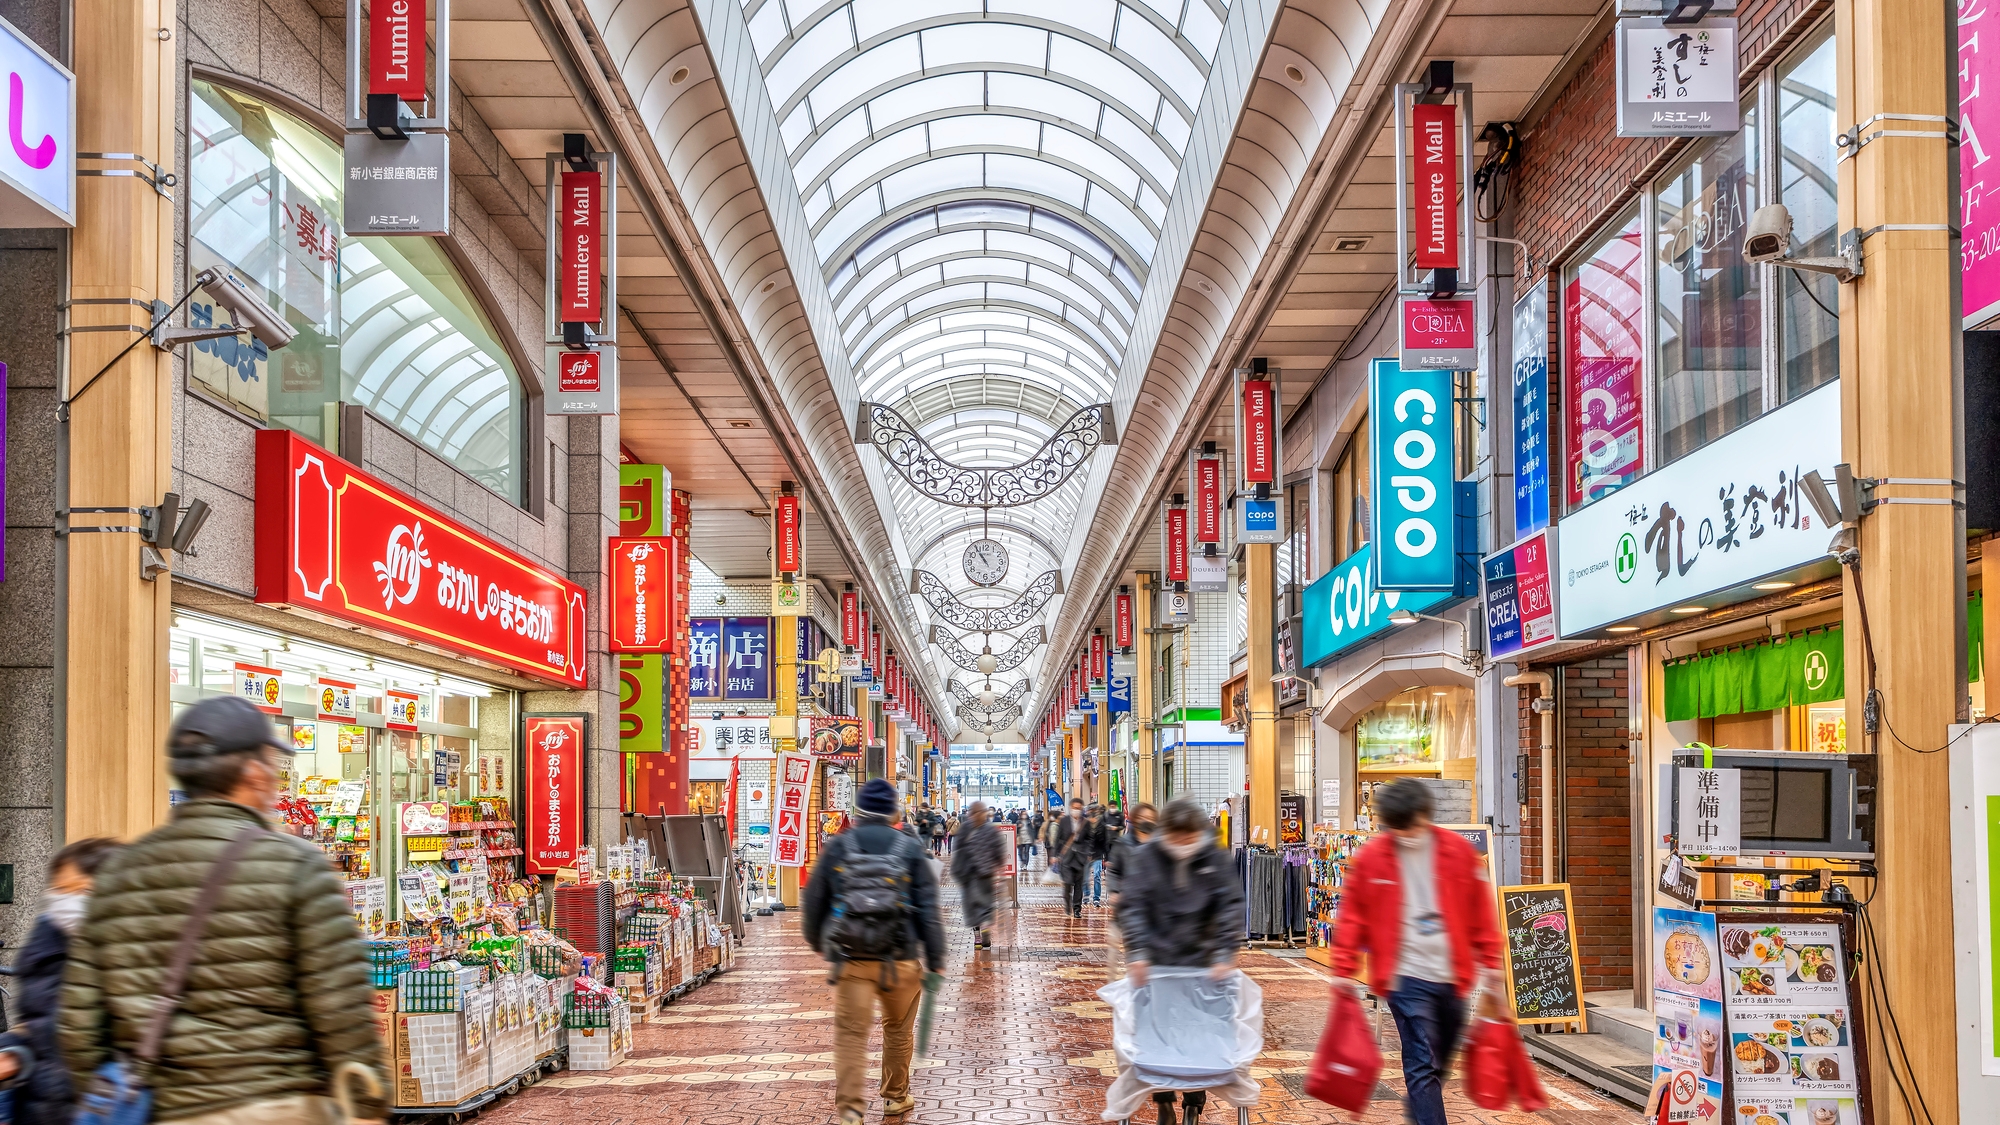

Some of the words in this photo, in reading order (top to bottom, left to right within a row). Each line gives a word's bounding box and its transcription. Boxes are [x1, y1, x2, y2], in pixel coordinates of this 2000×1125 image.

[1652, 111, 1711, 122] ルミエール
[1426, 120, 1443, 164] Mall
[350, 166, 438, 180] 新小岩銀座商店街
[368, 215, 419, 224] ルミエール
[573, 186, 590, 227] Mall
[1428, 172, 1445, 255] Lumiere
[1960, 180, 1984, 229] F
[573, 234, 590, 310] Lumiere
[1412, 314, 1466, 334] CREA
[1522, 298, 1537, 330] 3F
[1420, 356, 1460, 364] ルミエール
[1515, 347, 1544, 388] CREA
[1253, 390, 1264, 417] Mall
[1254, 421, 1265, 473] Lumiere
[1204, 467, 1213, 489] Mall
[1391, 388, 1437, 558] copo
[785, 503, 793, 525] Mall
[1174, 516, 1182, 535] Mall
[1204, 493, 1214, 535] Lumiere
[1248, 512, 1274, 520] copo
[785, 528, 793, 564] Lumiere
[1174, 538, 1182, 574] Lumiere
[1527, 545, 1537, 563] 2F
[1494, 562, 1504, 579] 3F
[1576, 569, 1589, 580] TOKYO
[1589, 560, 1609, 576] SETAGAYA
[437, 560, 553, 645] おかしのまちおか
[634, 564, 647, 645] おかしのまちおか
[1330, 555, 1402, 637] cop
[1520, 581, 1552, 615] CREA
[1489, 599, 1519, 628] CREA
[547, 650, 565, 667] 新小岩店
[548, 754, 560, 847] おかしのまちおか
[778, 760, 808, 861] 新台入替
[1697, 769, 1720, 843] 準備中
[540, 851, 570, 859] 新小岩店
[1674, 939, 1701, 953] おすすめ
[1675, 956, 1700, 965] メニュー
